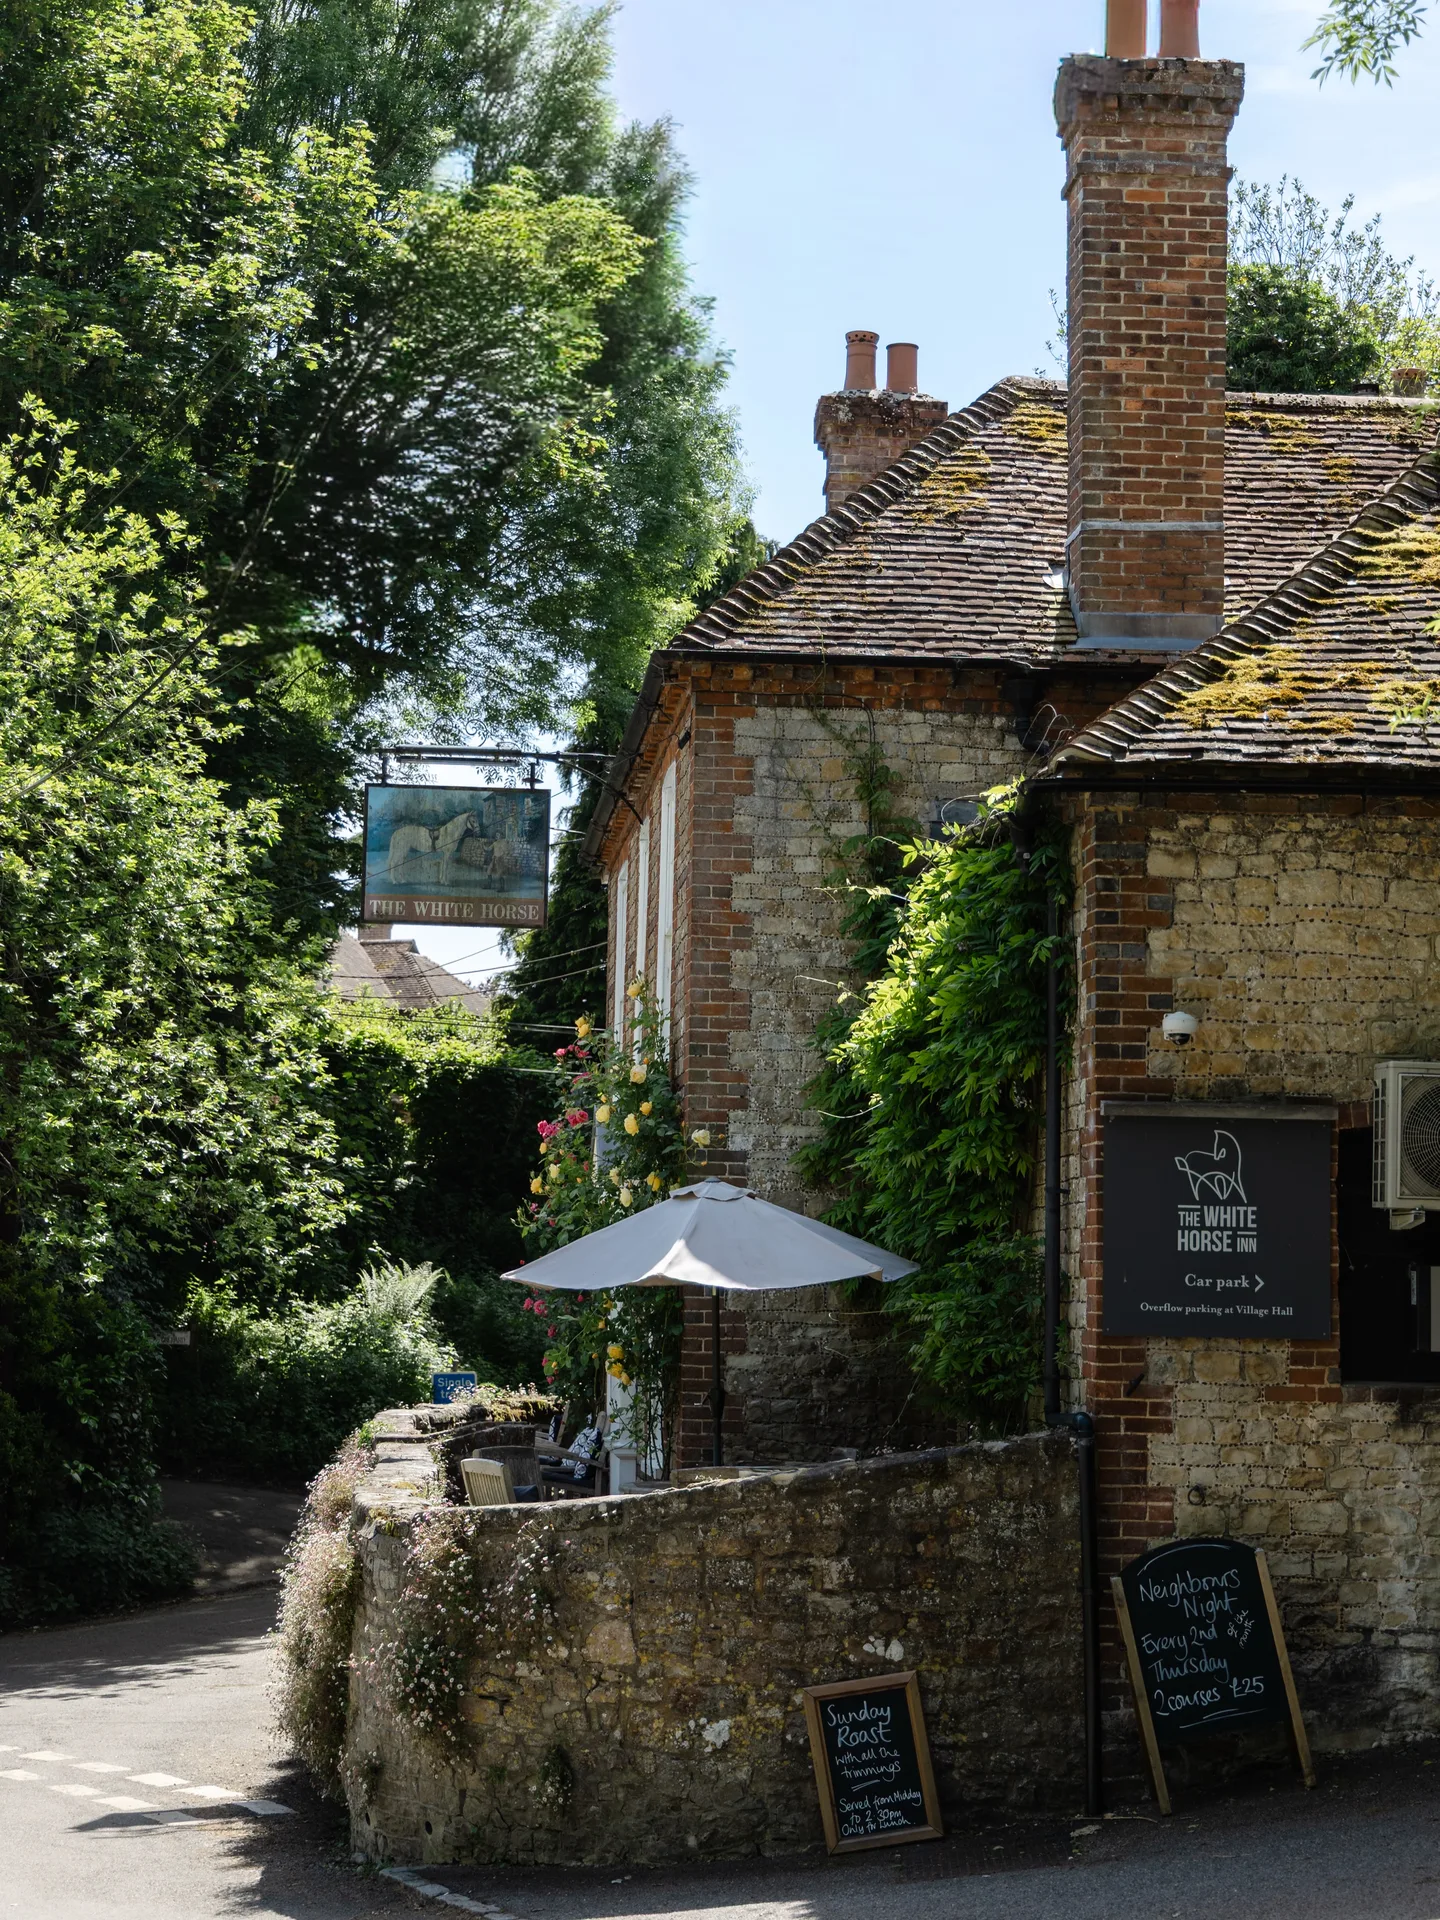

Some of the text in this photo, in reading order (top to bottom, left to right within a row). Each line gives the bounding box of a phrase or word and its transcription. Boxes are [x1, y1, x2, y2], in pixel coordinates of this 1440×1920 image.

[369, 900, 539, 920] THE WHITE HORSE
[1178, 1205, 1257, 1228] THE WHITE
[1177, 1229, 1257, 1252] HORSE INN
[1184, 1273, 1250, 1291] Car park
[1140, 1302, 1293, 1318] Overflow parking at Village Hall
[1139, 1568, 1241, 1607] Neighbours
[1183, 1591, 1238, 1623] Night
[1227, 1609, 1249, 1638] of the
[1141, 1624, 1218, 1661] Every 2nd
[1148, 1647, 1229, 1684] Thursday
[1229, 1675, 1265, 1698] £25
[827, 1700, 891, 1727] Sunday
[837, 1721, 892, 1748] Roast
[835, 1747, 900, 1766] with all the
[841, 1760, 901, 1783] trimmings
[839, 1788, 922, 1813] Served from Midday
[841, 1823, 865, 1836] Only
[866, 1821, 876, 1834] for
[849, 1812, 861, 1826] to
